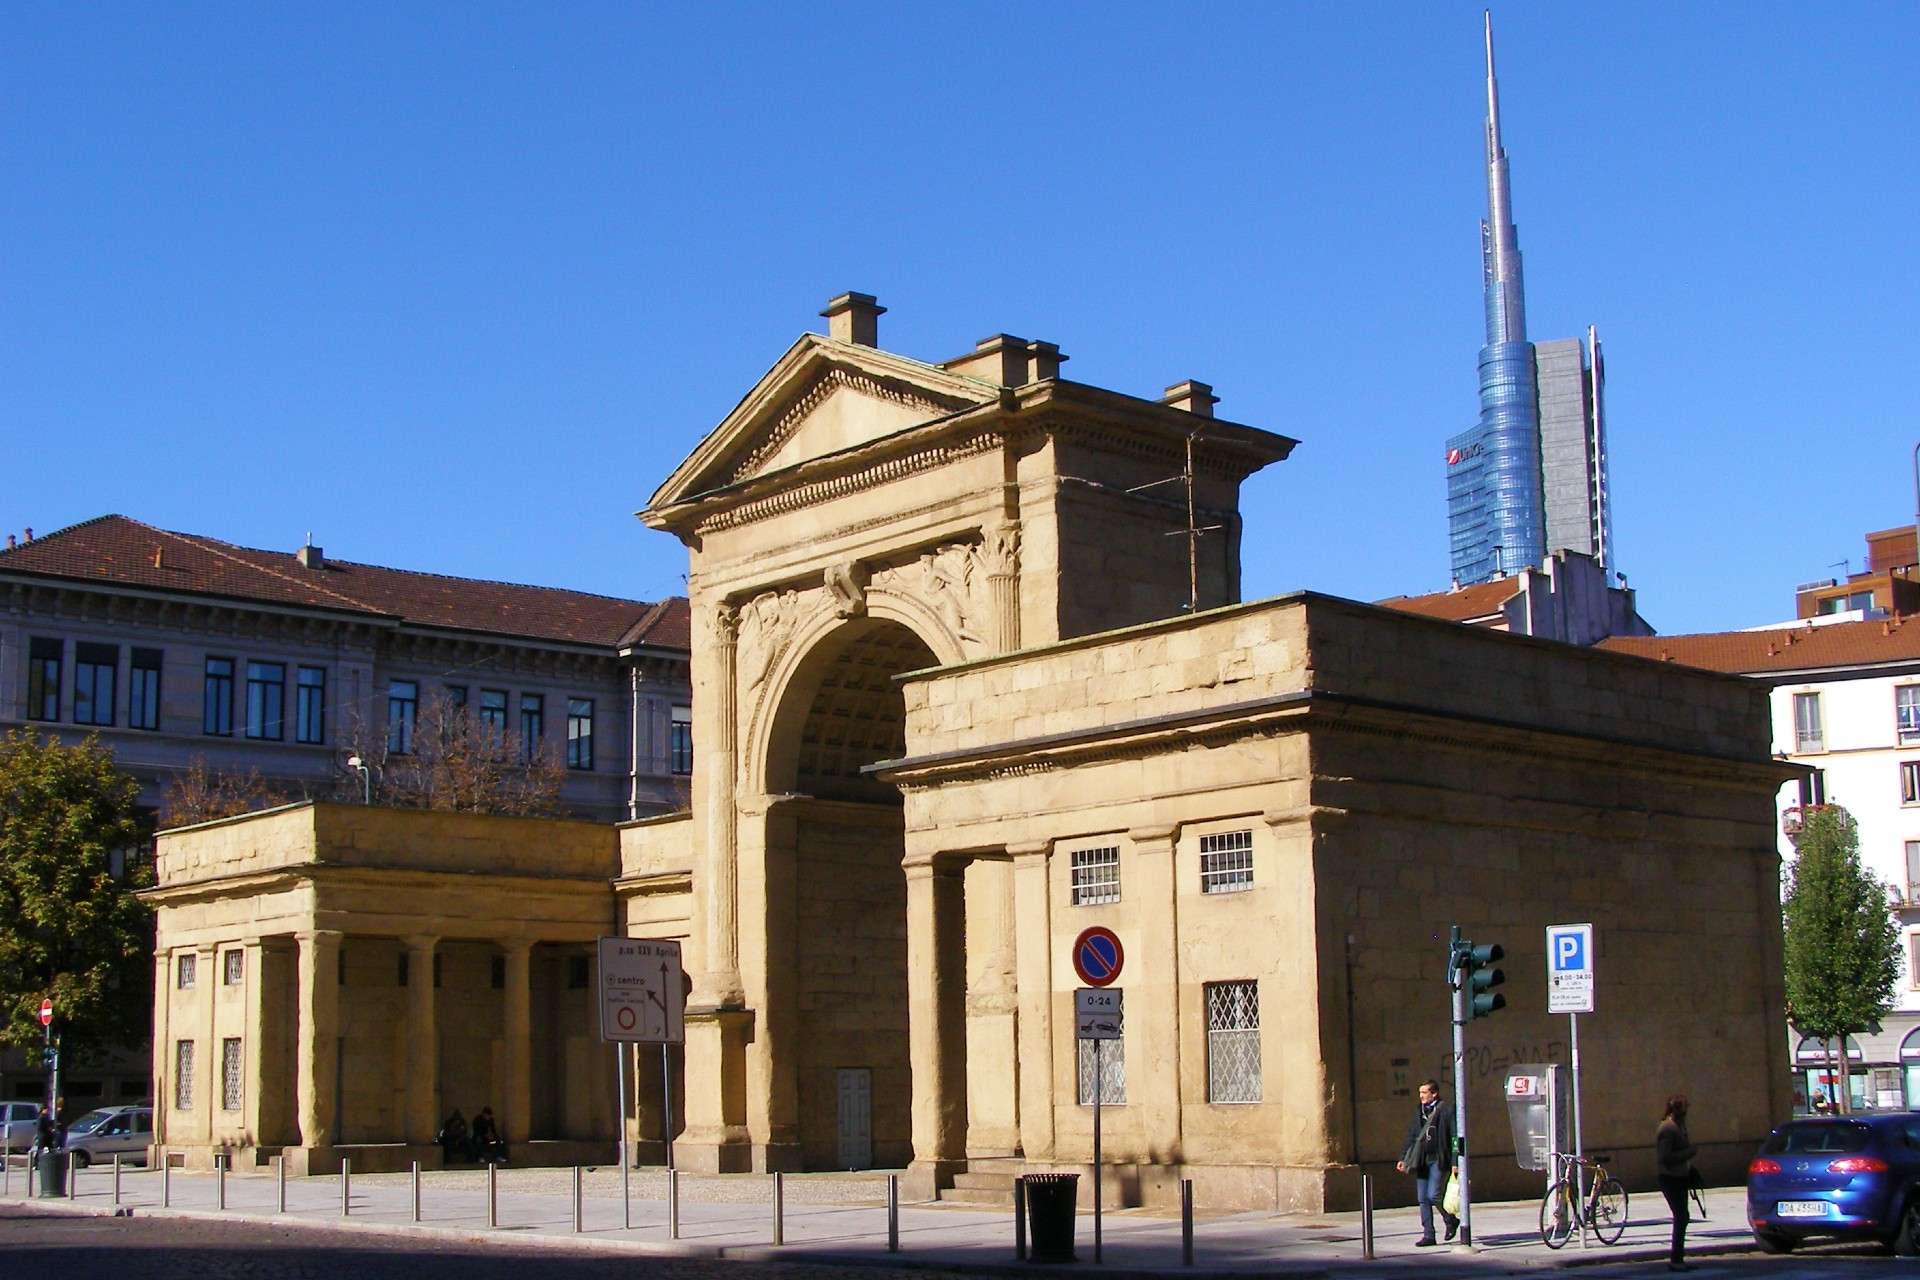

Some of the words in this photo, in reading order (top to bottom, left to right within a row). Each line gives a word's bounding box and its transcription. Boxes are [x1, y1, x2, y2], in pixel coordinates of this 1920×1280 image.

[638, 945, 652, 956] XXV
[656, 947, 677, 958] Aprile
[1559, 937, 1577, 967] P
[617, 976, 646, 986] centro
[1088, 997, 1110, 1005] 0-24
